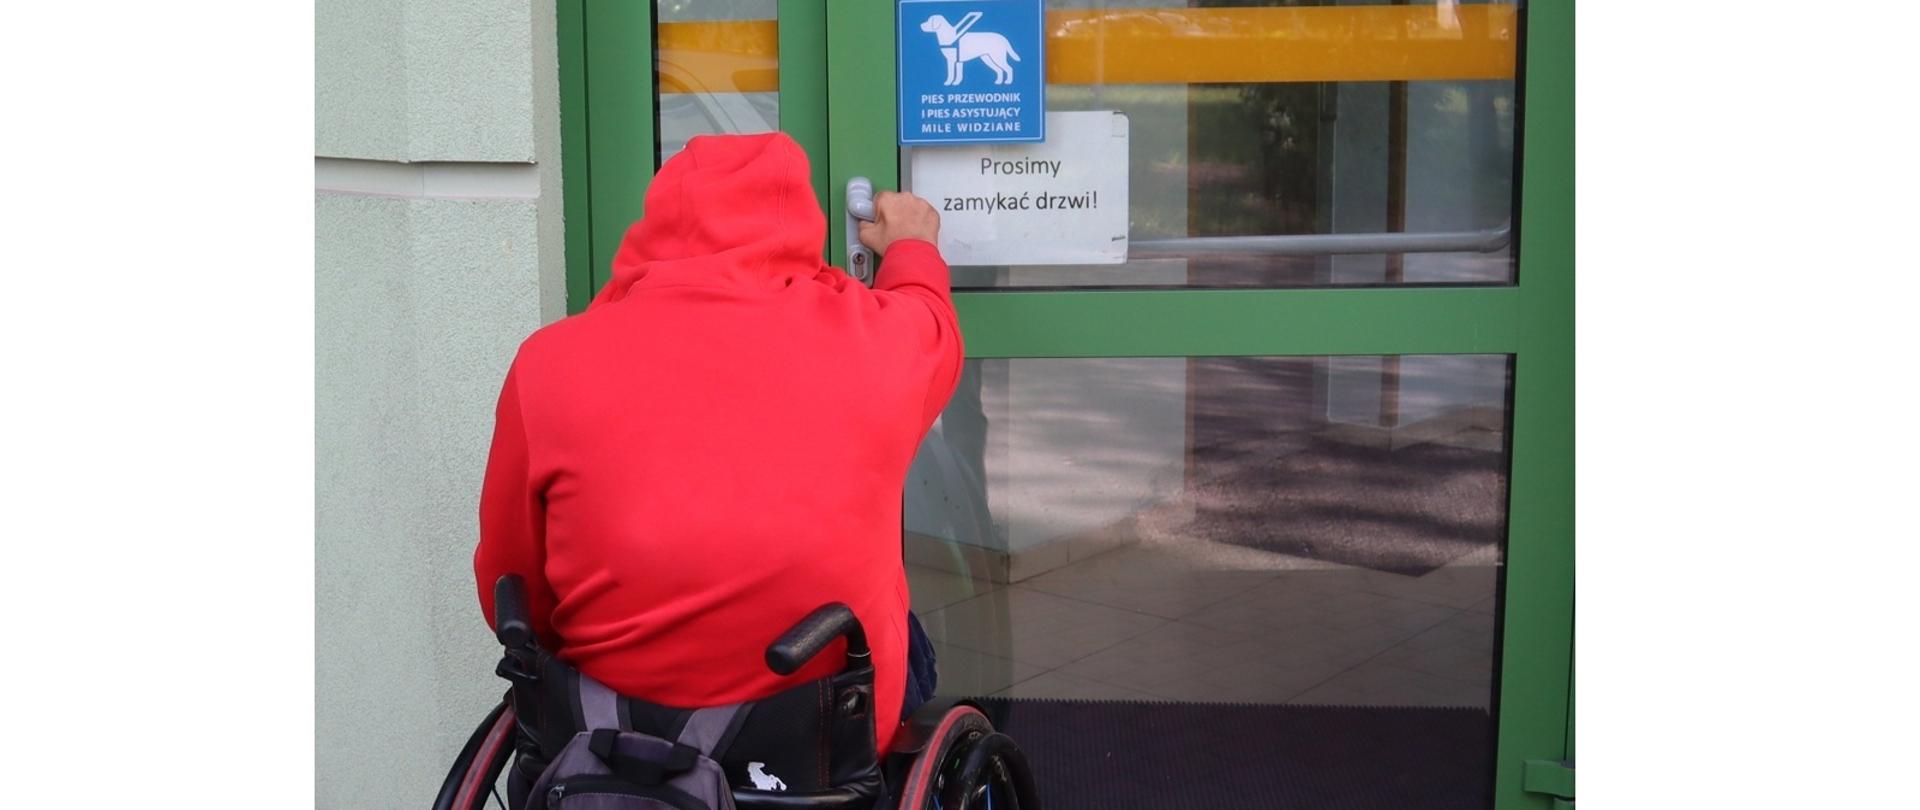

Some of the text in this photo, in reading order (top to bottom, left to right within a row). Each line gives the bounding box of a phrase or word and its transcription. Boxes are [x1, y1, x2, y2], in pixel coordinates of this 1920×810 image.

[921, 92, 1021, 104] PIES PRZEWODNIK
[921, 107, 1021, 120] I PIES ASYSTUJĄCY
[921, 122, 1021, 133] MILE WIDZIANE
[980, 157, 1061, 177] Prosimy
[943, 191, 1097, 213] zamykać drzwi!
